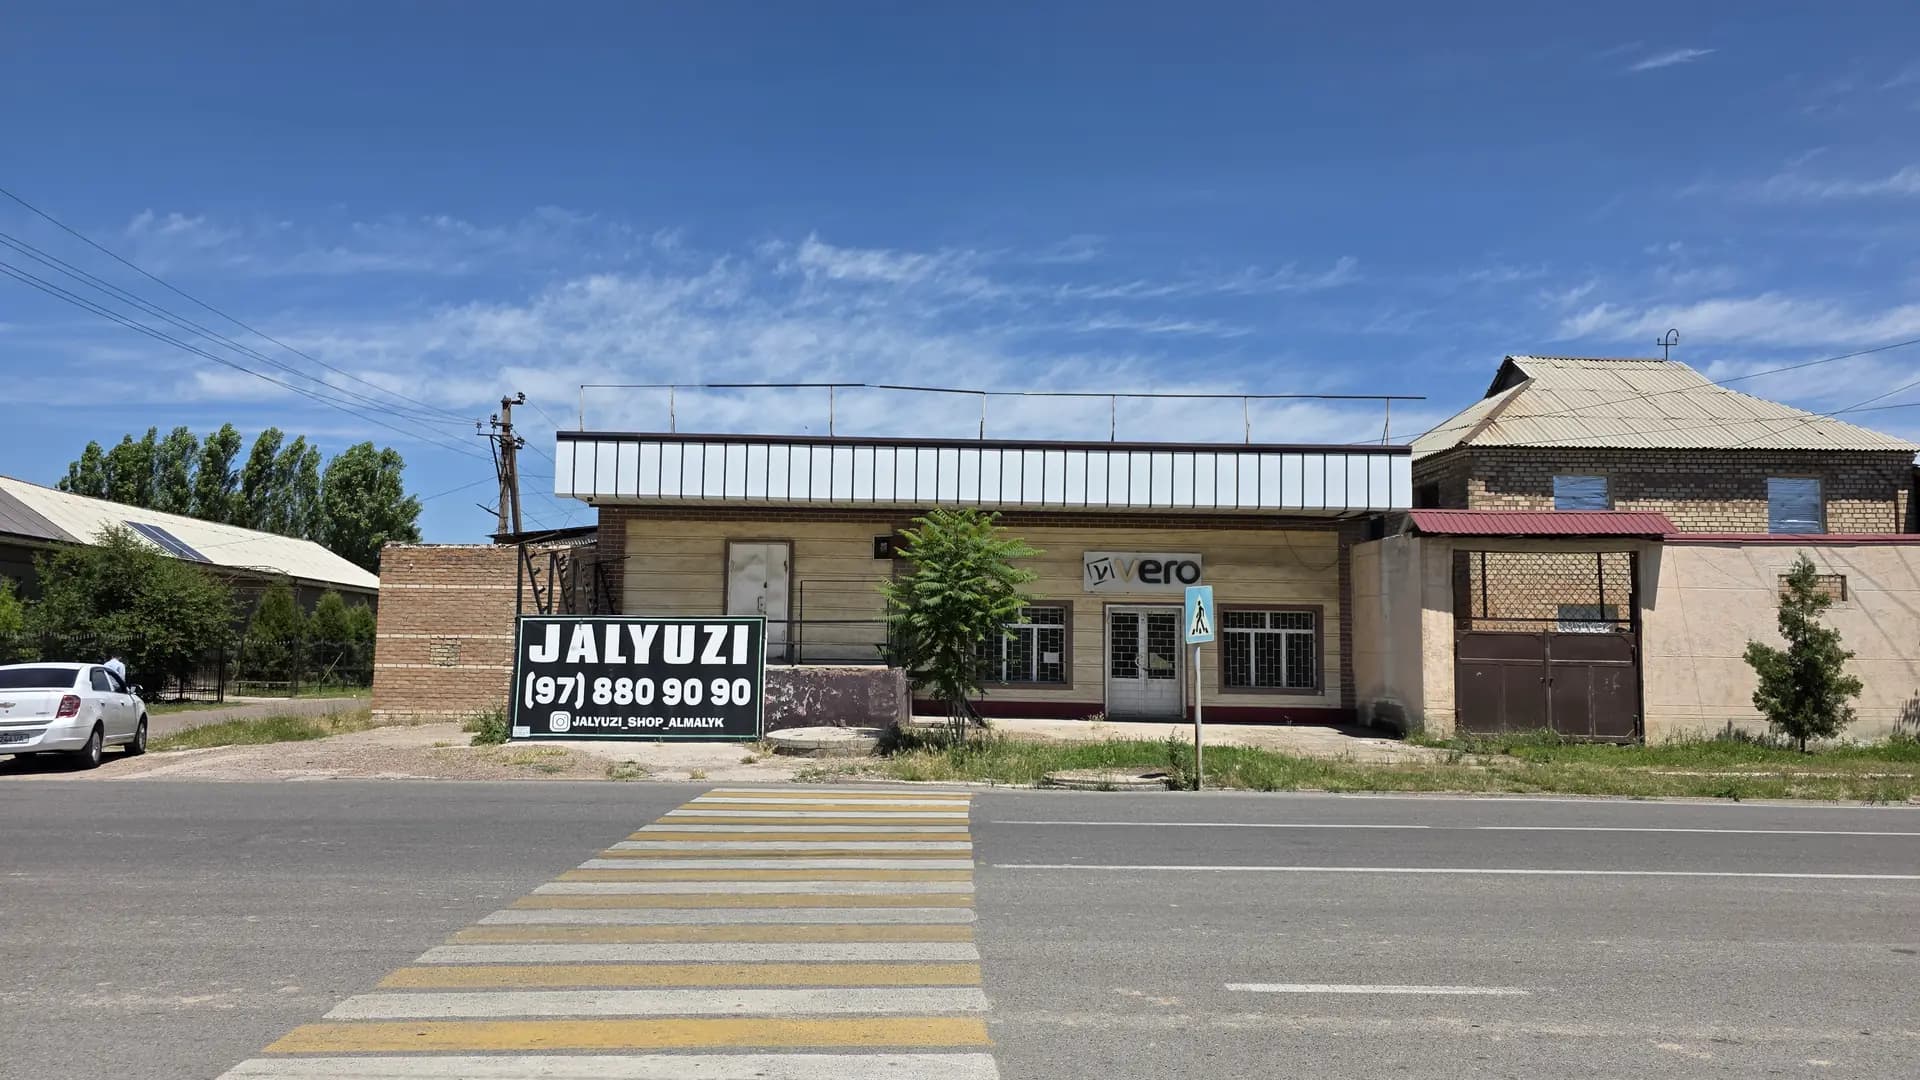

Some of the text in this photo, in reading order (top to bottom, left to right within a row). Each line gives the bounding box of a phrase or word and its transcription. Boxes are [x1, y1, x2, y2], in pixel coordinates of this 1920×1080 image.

[529, 624, 749, 665] JALYUZI
[526, 671, 751, 709] (97) 880 90 90
[573, 716, 724, 730] JALYUZI_SHOP_ALMALYK
